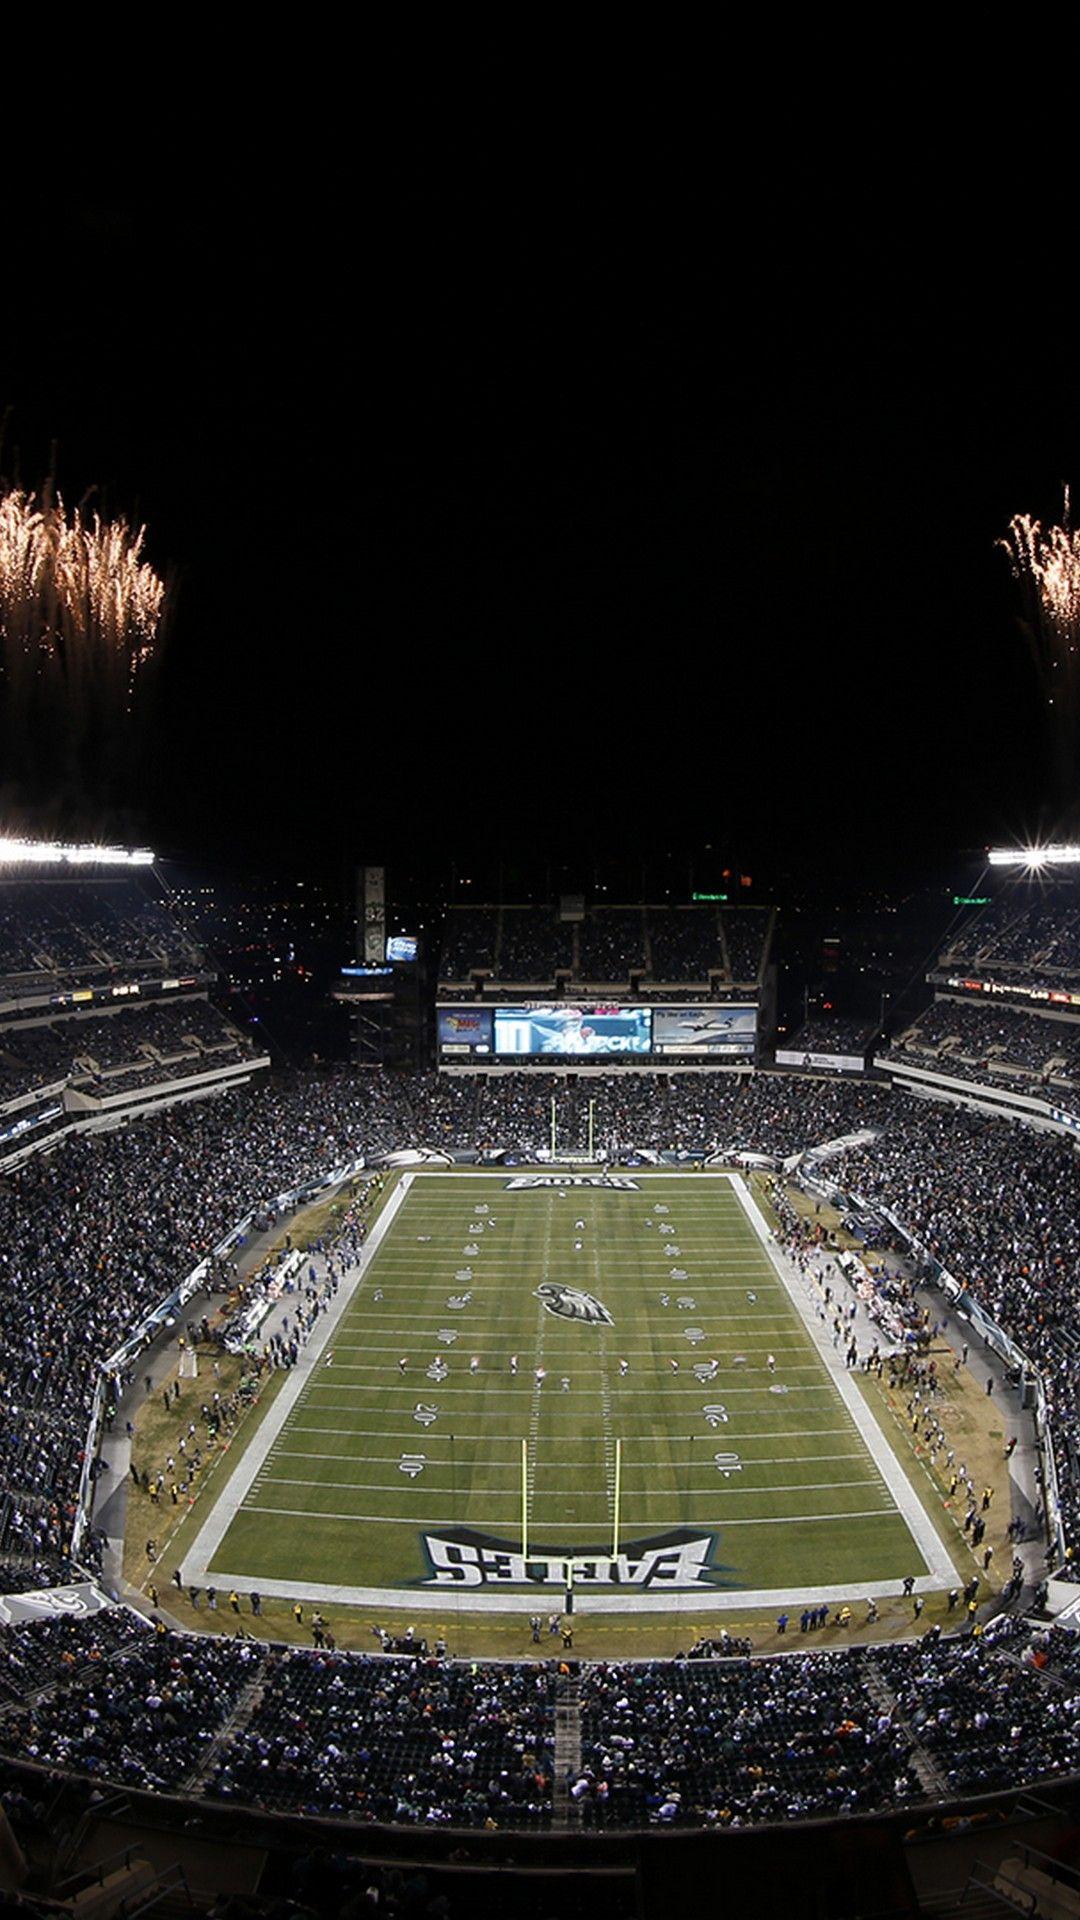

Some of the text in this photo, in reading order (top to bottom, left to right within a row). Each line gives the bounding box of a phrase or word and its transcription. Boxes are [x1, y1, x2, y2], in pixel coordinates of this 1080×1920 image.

[414, 1403, 439, 1421] 20
[703, 1405, 728, 1422] 20
[399, 1454, 426, 1472] 10
[714, 1453, 742, 1471] 10
[421, 1536, 718, 1588] EAGLES
